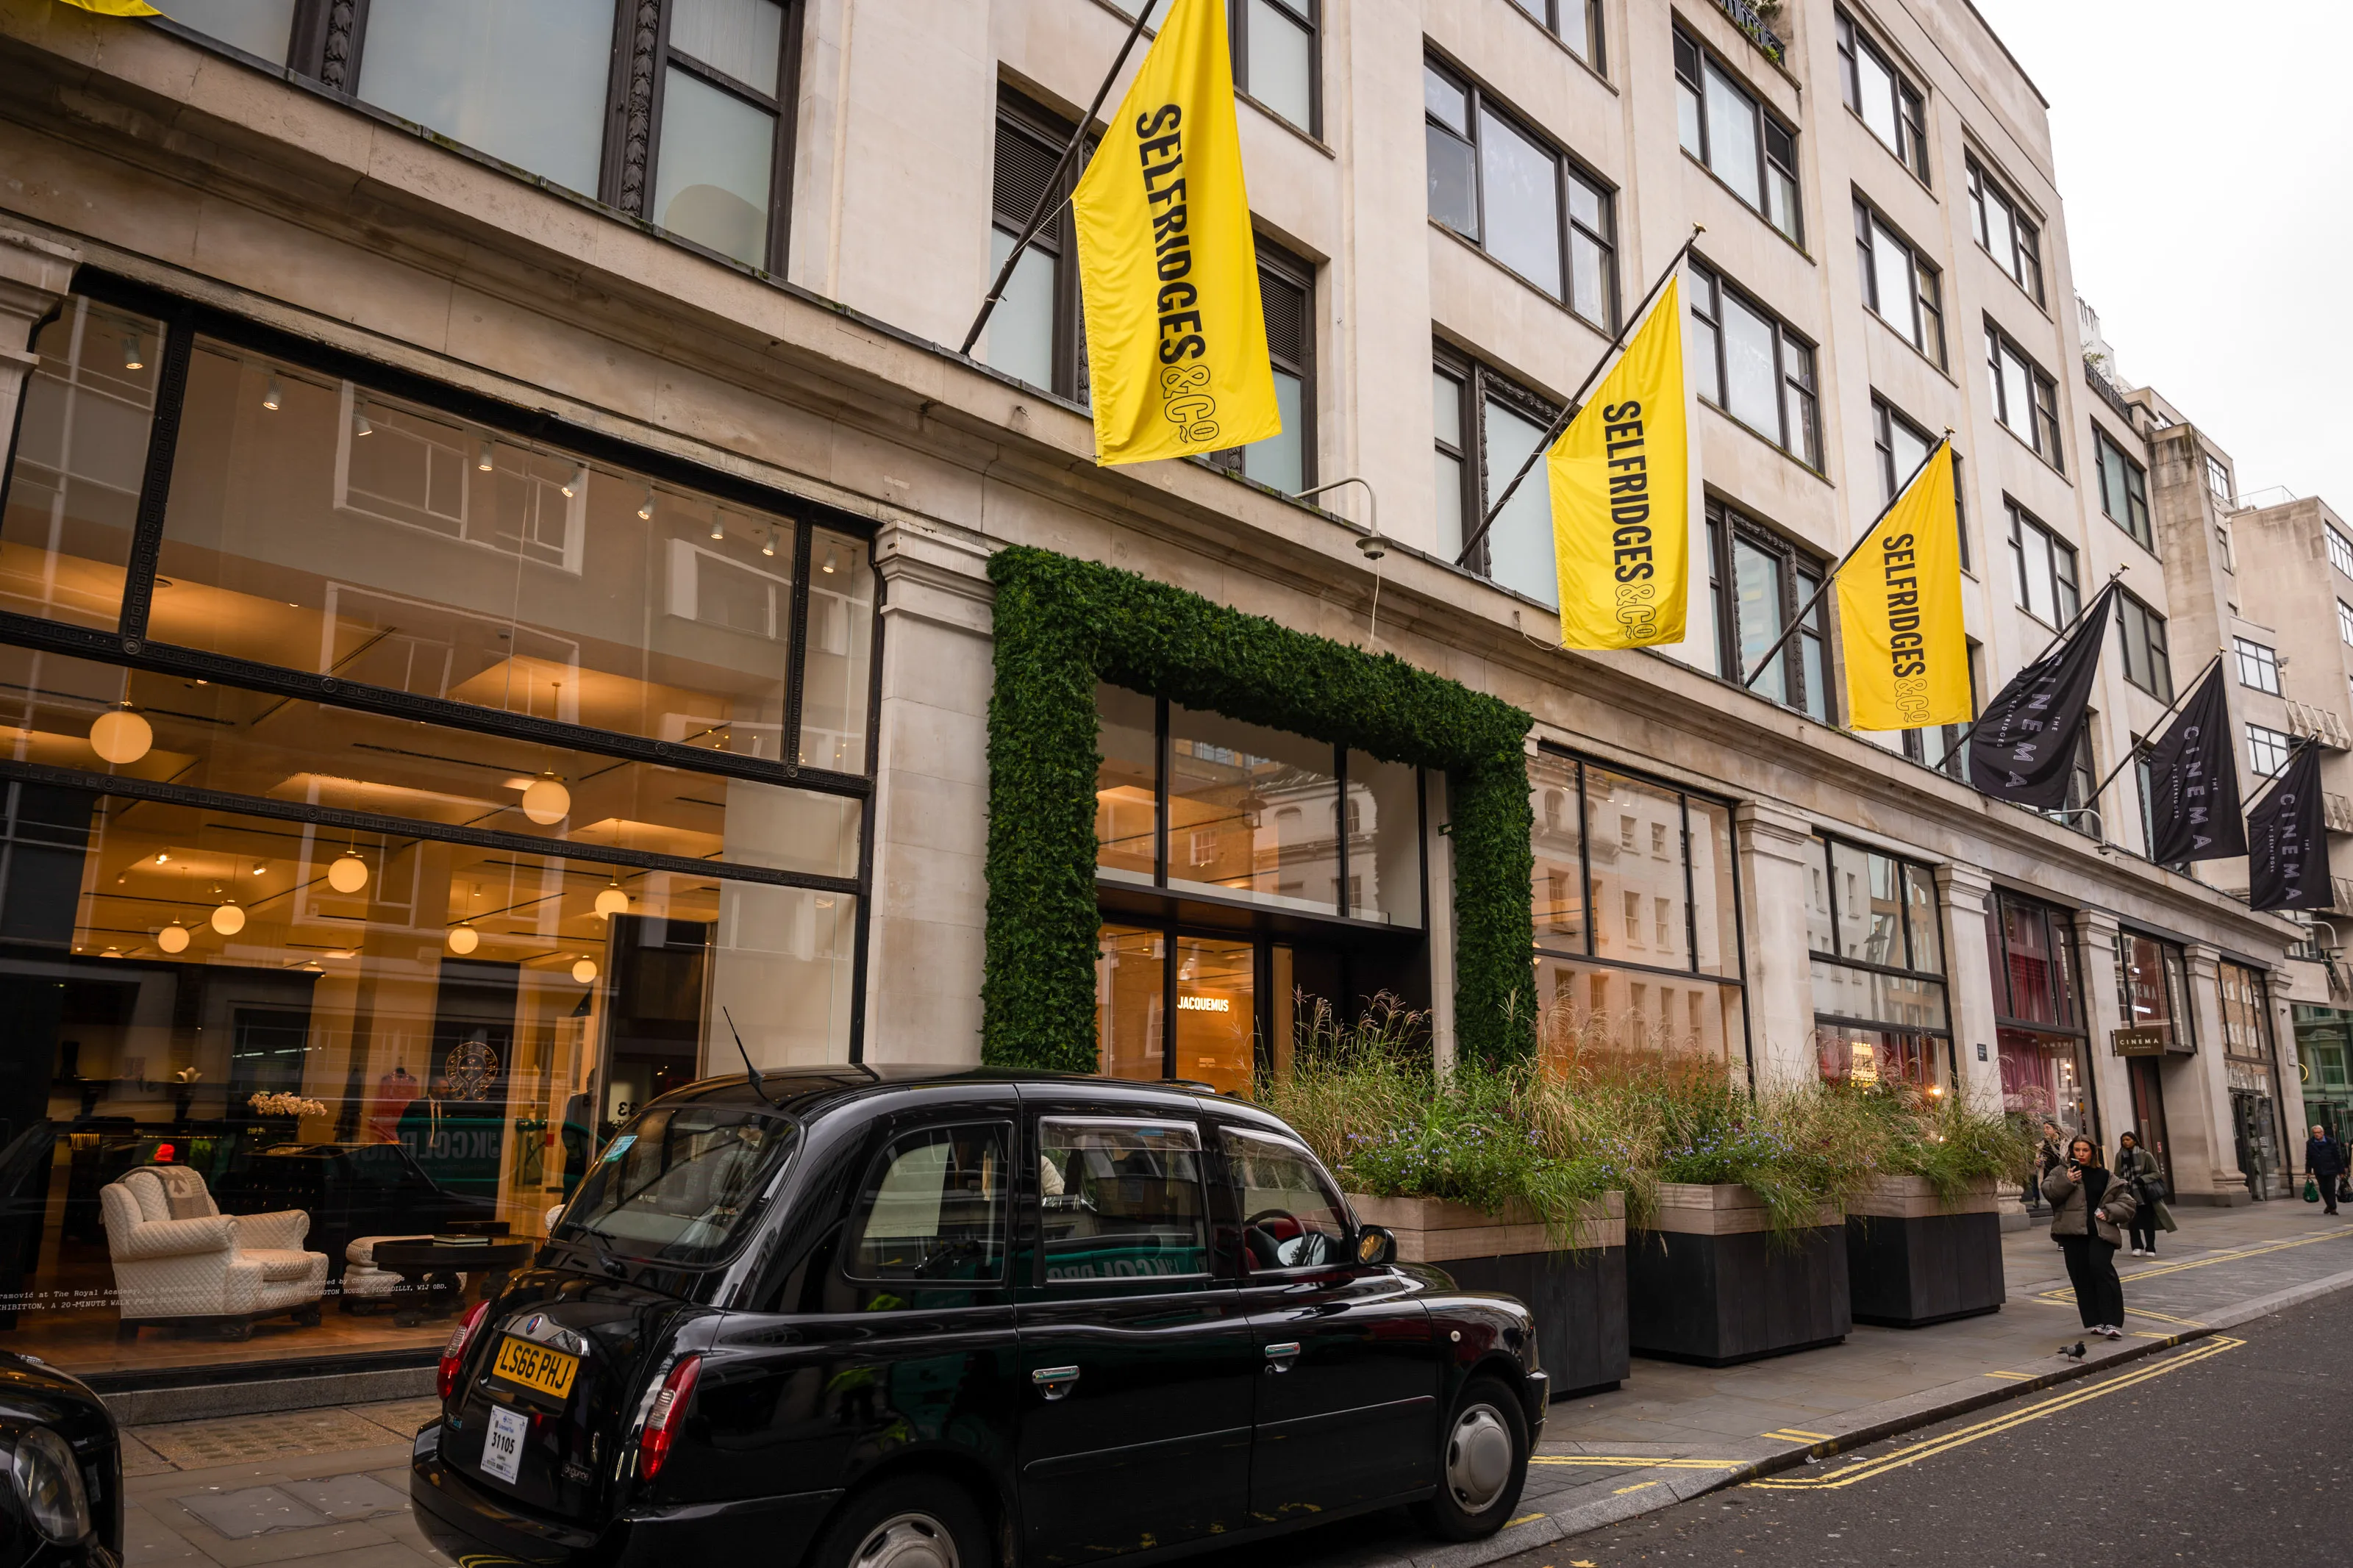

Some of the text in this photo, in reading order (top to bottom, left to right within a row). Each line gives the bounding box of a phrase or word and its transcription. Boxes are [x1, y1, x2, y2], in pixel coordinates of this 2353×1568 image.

[1996, 700, 2017, 748] SELFRIDGES
[2006, 654, 2063, 787] CINEMA
[2052, 716, 2060, 731] THE
[2184, 726, 2212, 850] CINEMA
[2280, 793, 2302, 901] CINEMA
[1177, 995, 1229, 1013] JACQUEMUS
[61, 1300, 106, 1308] 20-MINUTE
[297, 1289, 340, 1297] BURLINGTON
[371, 1284, 413, 1293] PICCADILLY,
[74, 1289, 98, 1297] Royal
[500, 1342, 571, 1389] LS66 PHJ
[491, 1431, 515, 1455] 31105
